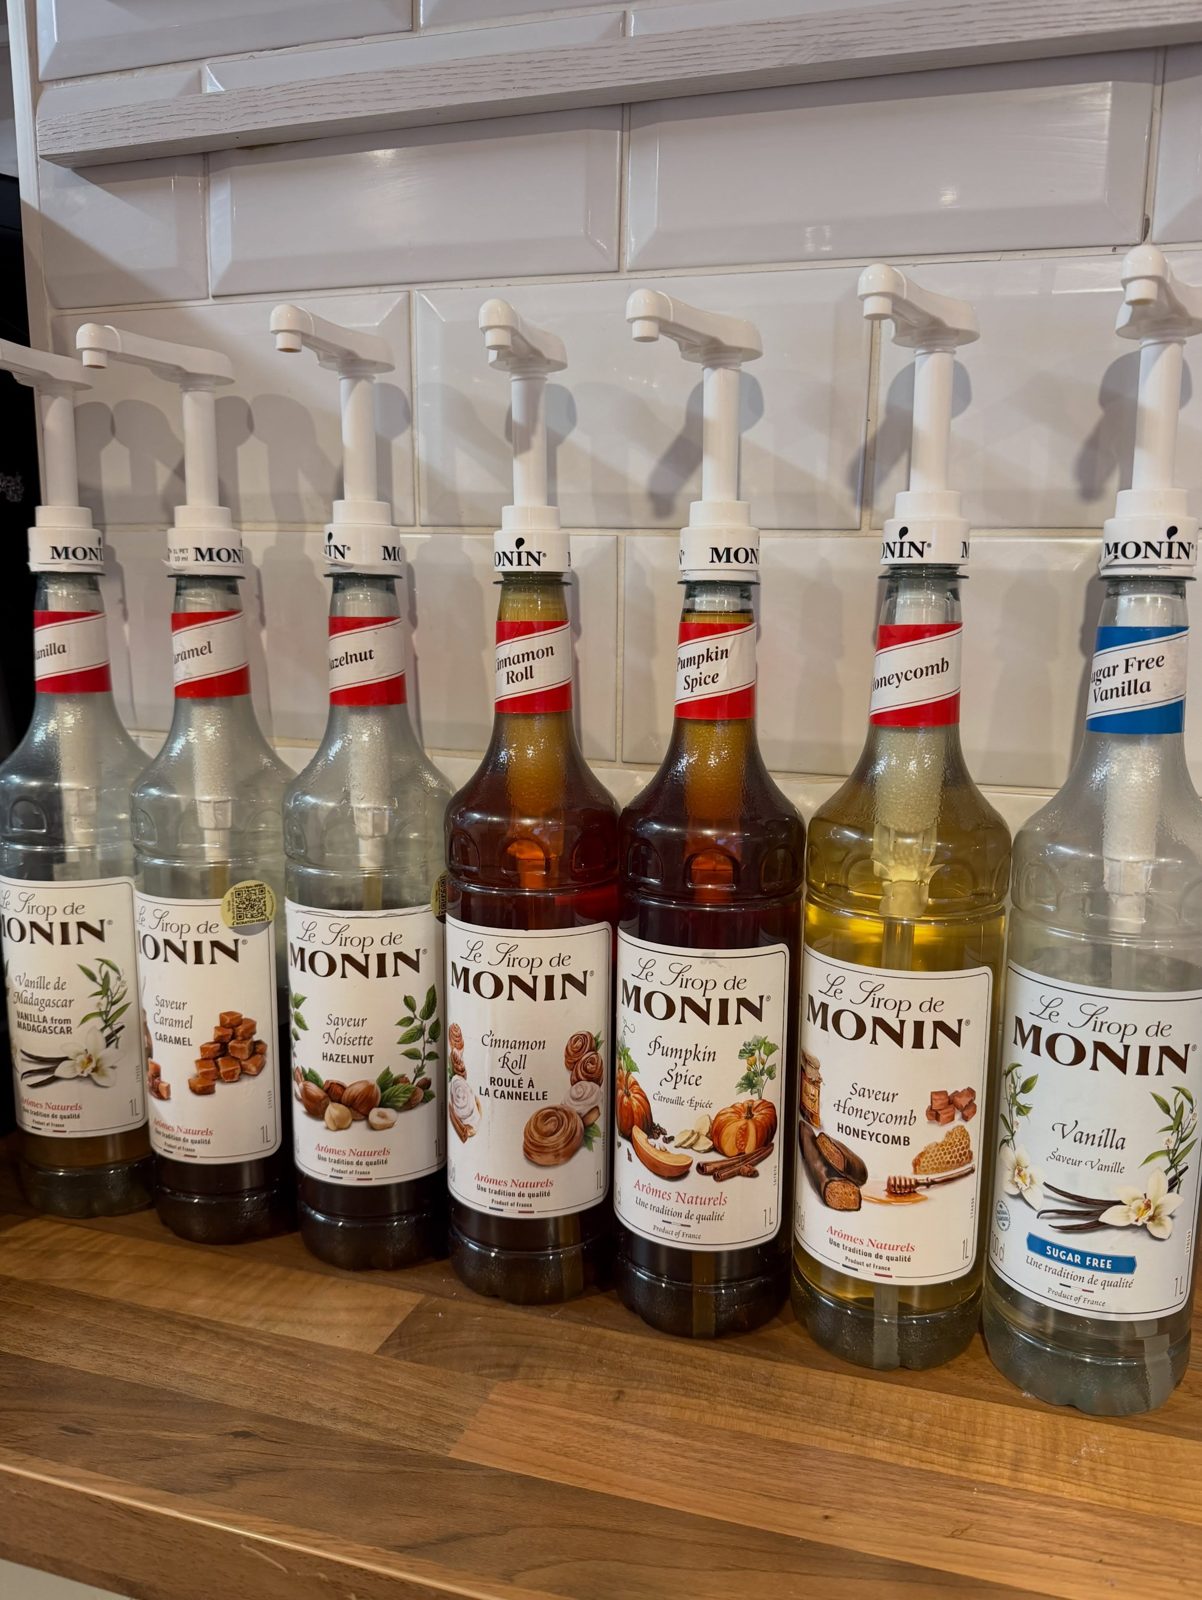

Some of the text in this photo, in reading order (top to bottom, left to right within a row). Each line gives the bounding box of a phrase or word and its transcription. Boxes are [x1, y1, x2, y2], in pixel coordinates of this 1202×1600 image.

[194, 547, 243, 564] MON
[329, 649, 375, 670] azelnut
[496, 645, 554, 673] innamon
[506, 665, 534, 685] Roll
[1091, 655, 1165, 685] ugar Free
[683, 672, 719, 692] Spice
[1093, 678, 1151, 703] Vanilla
[14, 892, 57, 921] Sirop
[63, 902, 86, 916] de
[149, 909, 190, 939] Sirop
[197, 921, 219, 934] de
[297, 921, 403, 953] Le Sirop de
[290, 942, 421, 979] MONIN
[458, 939, 571, 974] Le Sirop de
[15, 973, 66, 990] Vanille de
[451, 961, 588, 1002] MONIN
[631, 958, 747, 997] Le Sirop de
[13, 990, 74, 1011] Madagascar
[155, 995, 187, 1010] Saveur
[621, 978, 765, 1026] MONIN
[818, 973, 945, 1019] Le Sirop de
[17, 1011, 71, 1025] VANILLA from
[17, 1021, 73, 1034] MADAGASCAR
[153, 1010, 193, 1029] Caramel
[326, 1014, 367, 1028] Saveur
[806, 993, 964, 1050] MONIN
[1029, 995, 1172, 1043] Le Sirop de
[155, 1032, 192, 1046] CARAMEL
[322, 1028, 373, 1046] Noisette
[481, 1030, 546, 1050] Cinnamon
[1013, 1015, 1190, 1076] MONIN
[322, 1052, 374, 1064] HAZELNUT
[647, 1035, 717, 1067] Pumpkin
[498, 1052, 527, 1075] Roll
[489, 1076, 523, 1088] ROULÉ
[659, 1063, 702, 1089] Spice
[479, 1086, 548, 1101] LA CANNELLE
[652, 1091, 685, 1107] Citrouille
[849, 1082, 899, 1103] Saveur
[45, 1101, 82, 1111] Naturels
[833, 1097, 917, 1127] Honeycomb
[177, 1125, 213, 1136] Naturels
[260, 1124, 271, 1144] 1L
[837, 1122, 911, 1146] HONEYCOMB
[1051, 1120, 1126, 1150] Vanilla
[328, 1157, 354, 1165] tradition
[349, 1147, 391, 1157] Naturels
[1046, 1148, 1125, 1174] Saveur Vanille
[488, 1187, 516, 1198] tradition
[517, 1190, 526, 1198] de
[527, 1190, 551, 1199] qualité
[510, 1178, 554, 1188] Naturels
[675, 1191, 728, 1206] Naturels
[635, 1197, 726, 1224] Une tradition de qualité
[763, 1207, 774, 1229] 1L
[652, 1225, 701, 1240] Product of France
[828, 1237, 912, 1264] Une tradition de qualité
[866, 1238, 916, 1253] Naturels
[844, 1255, 866, 1267] Product
[872, 1263, 891, 1271] France
[1046, 1245, 1113, 1270] SUGAR FREE
[1025, 1255, 1135, 1291] Une tradition de qualité
[1174, 1275, 1184, 1297] 1L
[1047, 1287, 1106, 1308] Product of France
